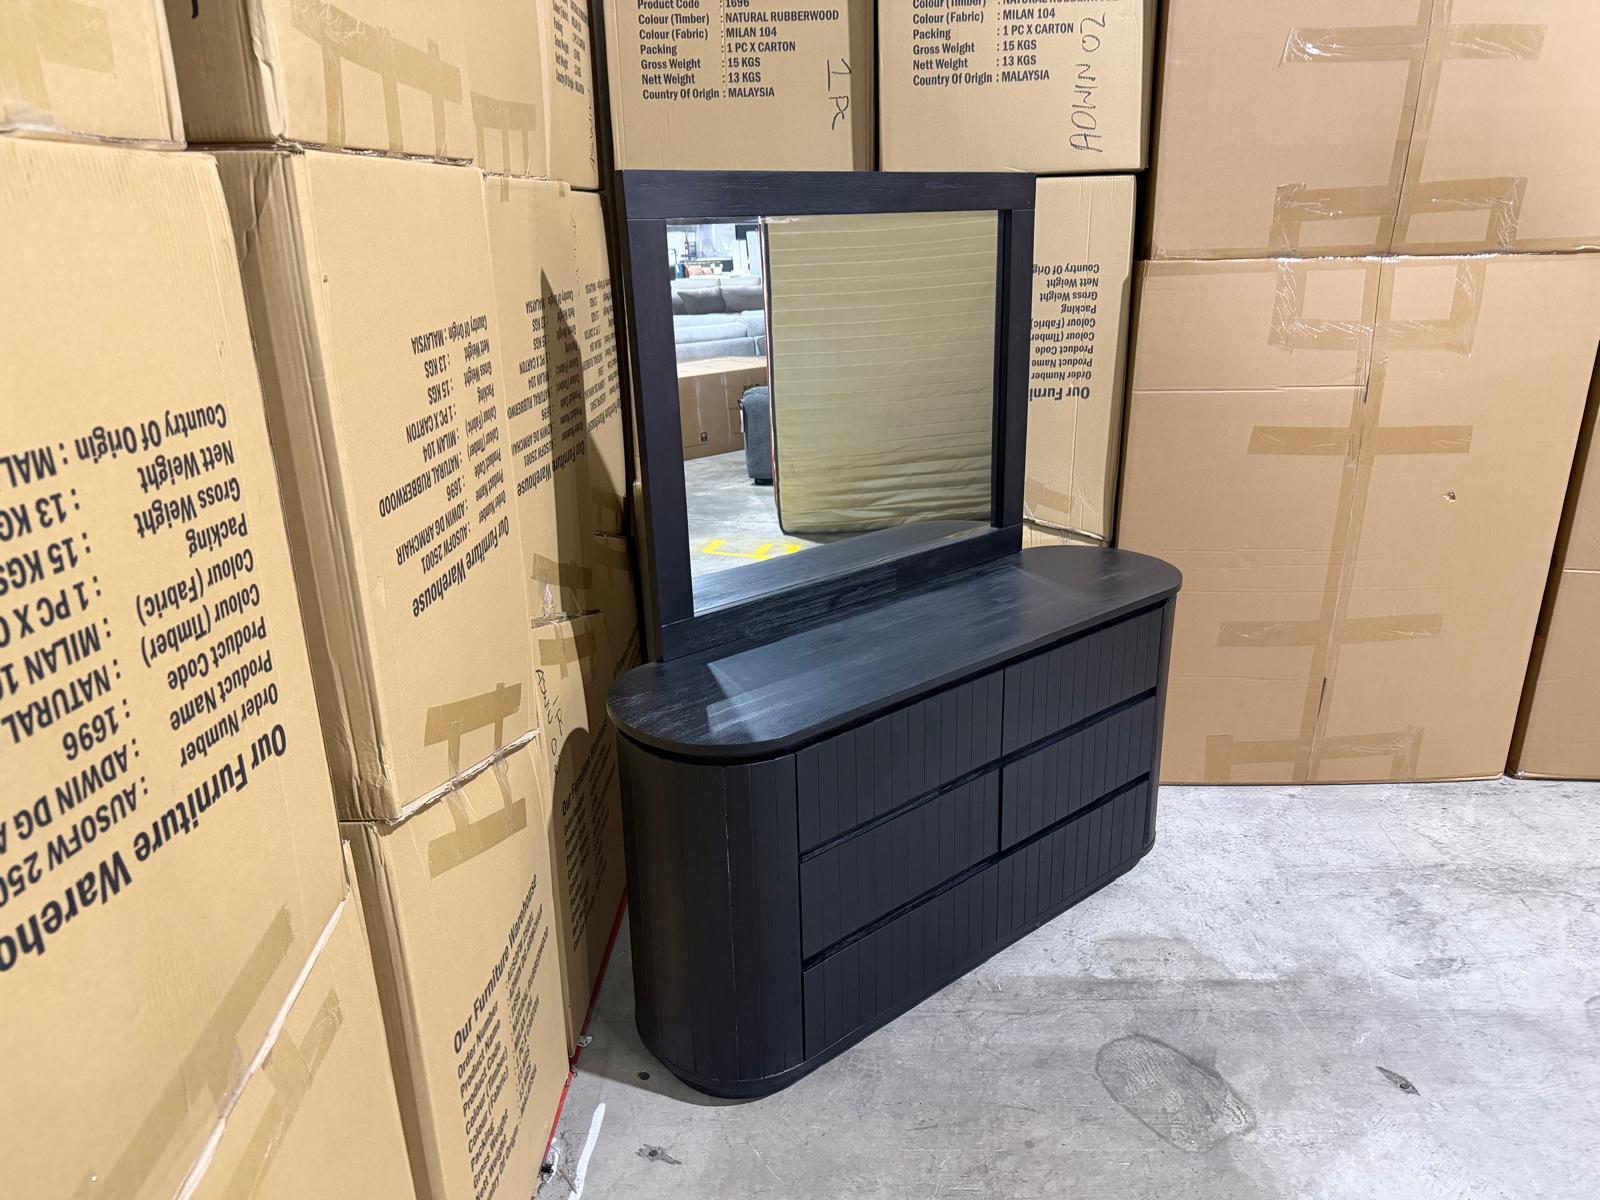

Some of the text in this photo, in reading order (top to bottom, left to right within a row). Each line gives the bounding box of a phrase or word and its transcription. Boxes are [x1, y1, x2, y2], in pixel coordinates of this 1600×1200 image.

[638, 0, 749, 9] Product Code 1696
[638, 10, 839, 26] Colour (Timber) NATURAL RUBBERWOOD
[913, 9, 1055, 24] Colour (Fabric) MILAN 104
[639, 27, 777, 41] Colour (Fabric) MILAN 104
[913, 23, 1074, 40] Packing 1 PC X CARTON
[913, 40, 1036, 55] Gross Weight 15 KGS
[640, 42, 795, 56] Packing 1 PC X CARTON
[641, 58, 760, 71] Gross Weight 15 KGS
[913, 55, 1036, 71] Nett Weight 13 KGS
[642, 72, 761, 86] Nett Weight 13 KGS
[643, 87, 775, 101] Country Of Origin MALAYSIA
[913, 70, 1050, 87] Country Of Origin MALAYSIA
[1069, 63, 1104, 153] ADWIN
[1046, 277, 1098, 288] Nett Weight
[1052, 265, 1062, 275] Of
[1064, 263, 1100, 274] Country
[1040, 291, 1098, 302] Gross Weight
[1060, 304, 1096, 314] Packing
[1066, 318, 1096, 328] Colour
[1066, 332, 1094, 341] Colour
[411, 330, 444, 355] MALAYSIA
[1035, 345, 1094, 356] Product Code
[424, 355, 447, 378] 13 KGS
[1031, 371, 1092, 381] Order Number
[1032, 358, 1092, 368] Product Name
[428, 380, 450, 405] 15 KGS
[1066, 386, 1090, 400] Our
[140, 420, 162, 451] Of
[165, 404, 226, 438] Country
[406, 405, 453, 443] 1 PC X CARTON
[74, 426, 137, 464] Origin
[200, 440, 234, 472] Nett
[423, 430, 456, 463] MILAN 104
[137, 452, 200, 494] Weight
[379, 454, 460, 517] NATURAL RUBBERWOOD
[517, 463, 552, 496] Warehouse
[198, 477, 240, 508] Gross
[446, 477, 462, 502] 1696
[35, 493, 66, 528] 13
[134, 494, 198, 538] Weight
[435, 516, 445, 536] DG
[445, 501, 464, 528] ADWIN
[185, 513, 248, 558] Packing
[396, 523, 434, 566] ARMCHAIR
[444, 524, 467, 557] AUSOFW
[47, 537, 78, 574] 15
[208, 549, 253, 587] Colour
[412, 516, 509, 617] Our Furniture Warehouse
[421, 544, 442, 574] 25001
[36, 589, 71, 627] PC
[73, 582, 88, 610] 1
[136, 568, 204, 626] (Fabric)
[215, 584, 260, 622] Colour
[12, 604, 33, 638] X
[141, 604, 211, 668] (Timber)
[24, 623, 101, 684] MILAN
[62, 616, 266, 760] Product Code 1696
[217, 650, 272, 703] Product
[1, 665, 111, 744] NATURAL
[170, 687, 217, 731] Name
[241, 683, 278, 722] Order
[181, 710, 240, 768] Number
[251, 724, 286, 770] Our
[55, 744, 127, 815] ADWIN
[13, 795, 52, 840] DG
[134, 753, 248, 862] Furniture
[48, 782, 136, 871] AUSOFW
[454, 874, 536, 1054] Our Furniture Warehouse
